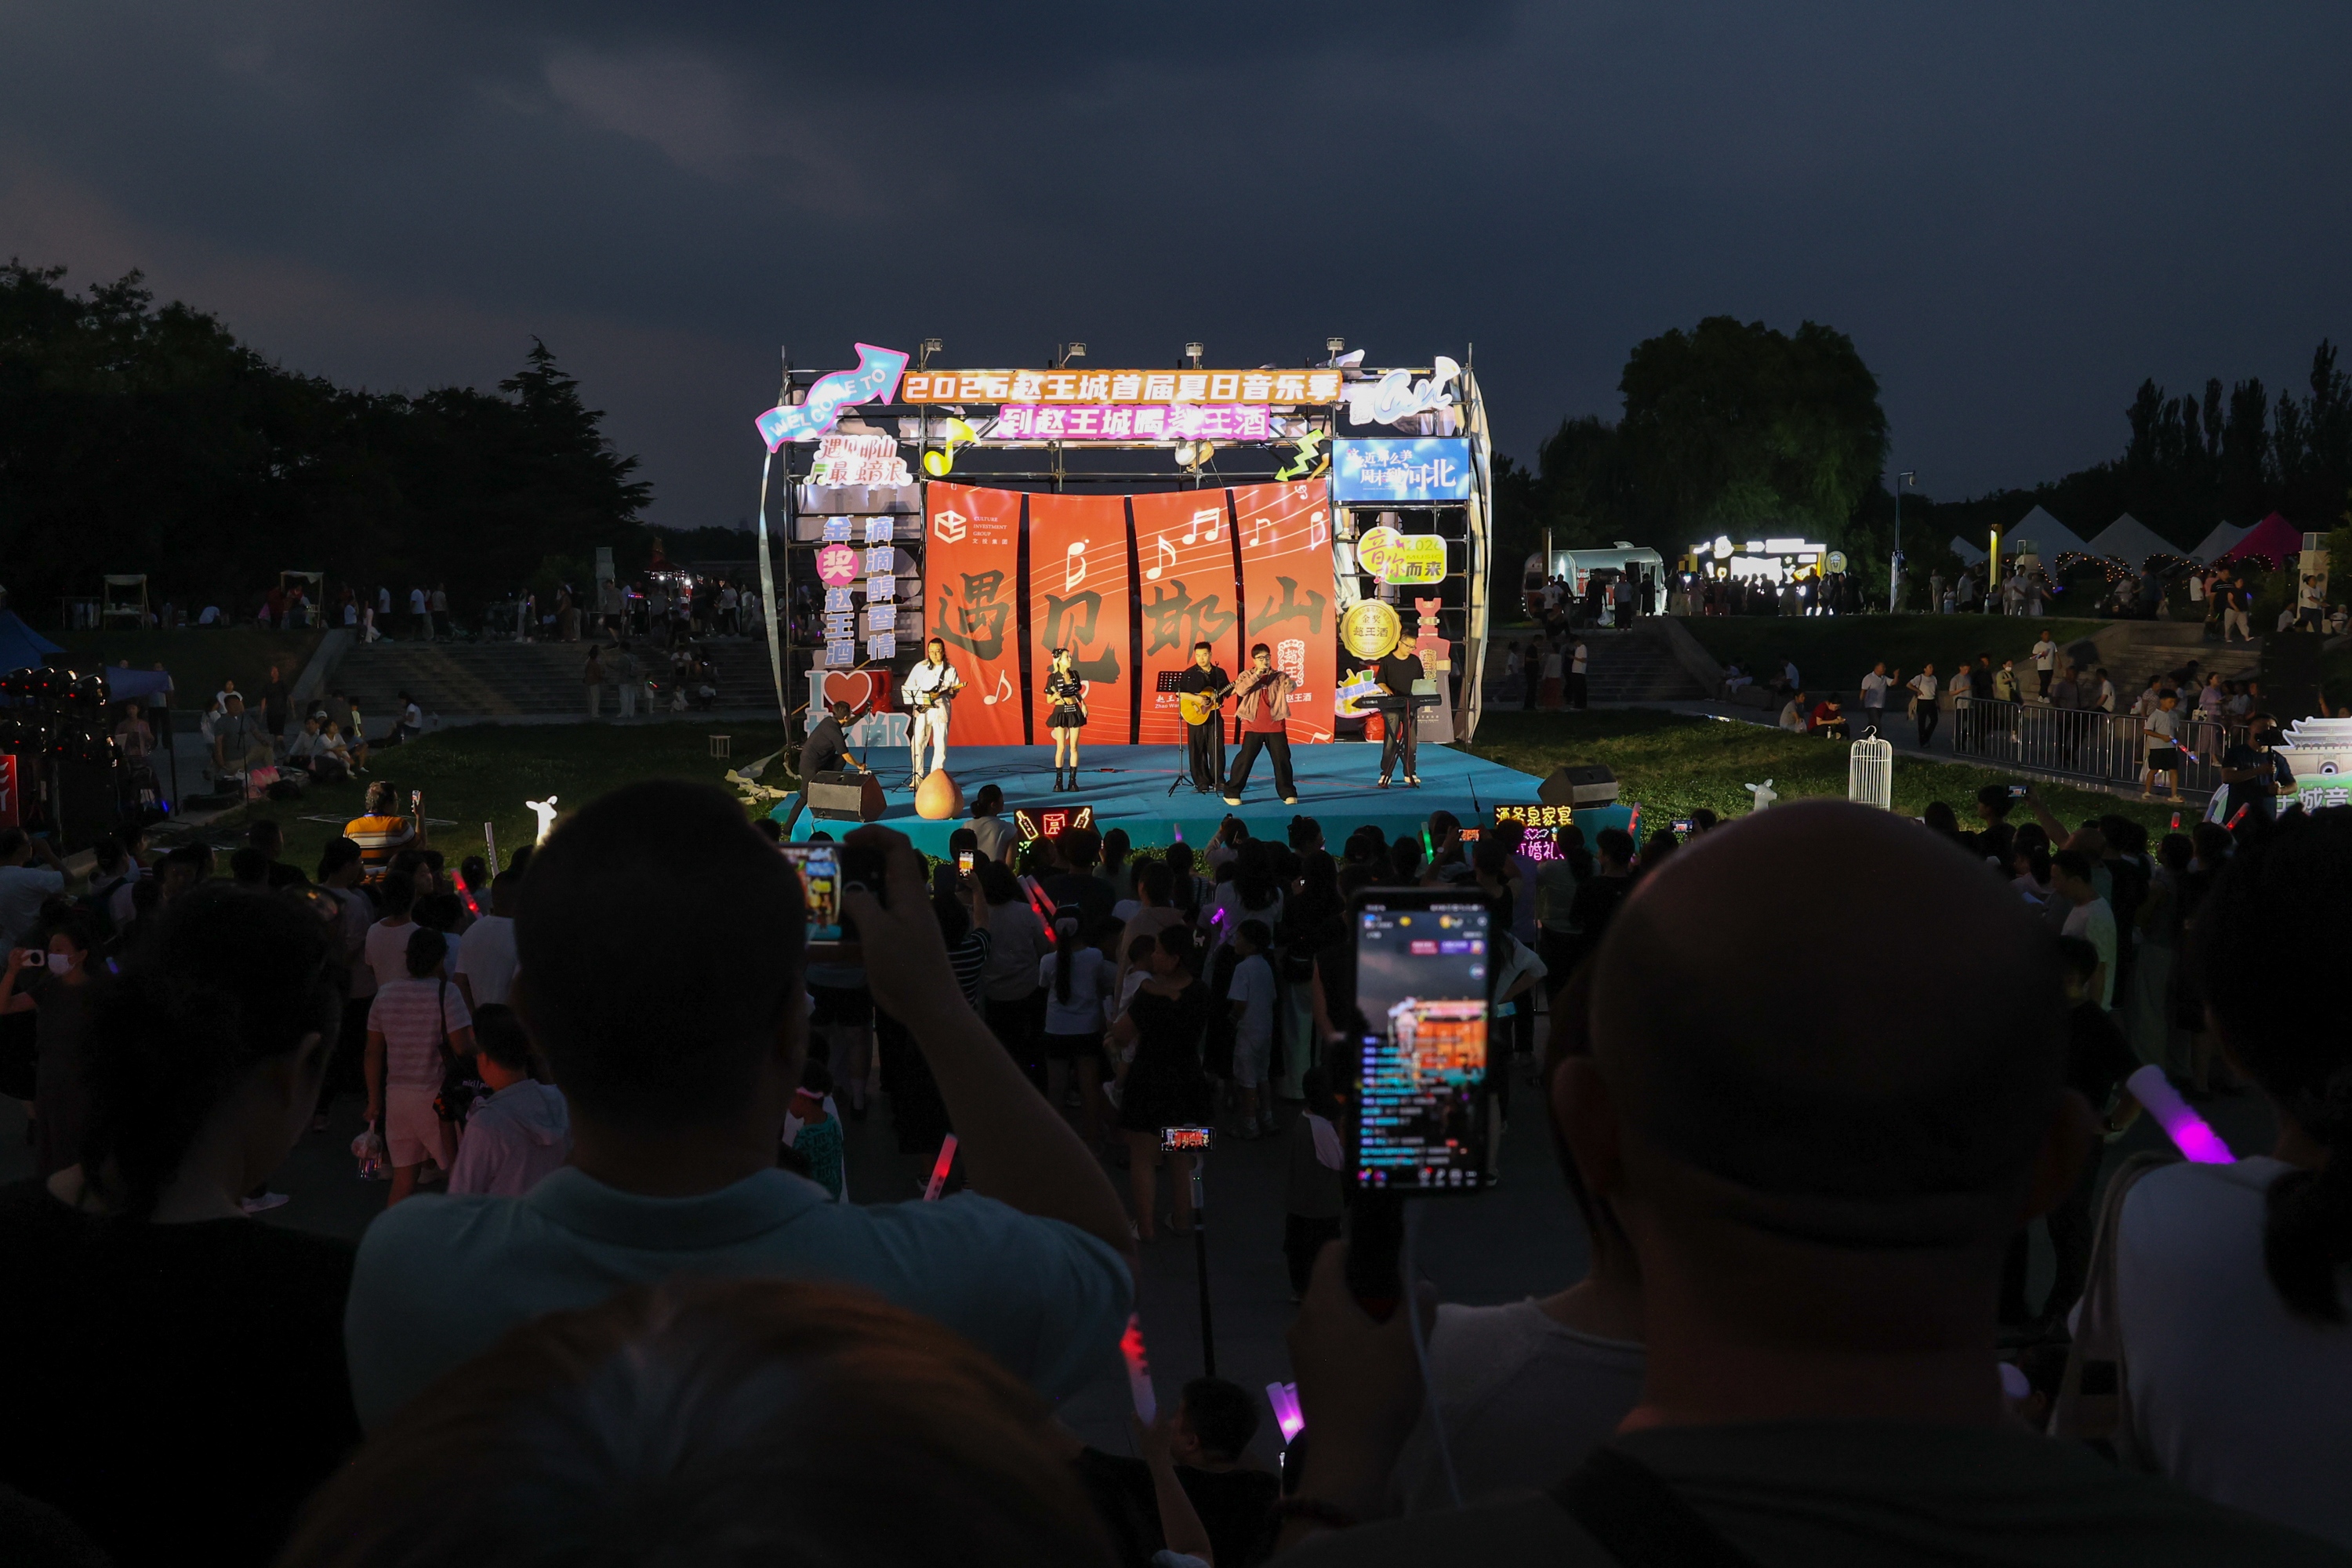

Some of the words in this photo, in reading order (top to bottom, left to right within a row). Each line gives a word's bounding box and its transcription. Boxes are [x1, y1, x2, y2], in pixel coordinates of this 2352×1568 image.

[906, 374, 1339, 402] 2026赵王城首届夏日音乐季
[769, 380, 857, 437] WELCOE
[860, 368, 886, 390] TO
[1406, 539, 1442, 551] 2026
[822, 516, 855, 665] 金奖赵王酒
[865, 516, 897, 660] 滴滴醇香情
[1362, 614, 1381, 624] 金奖
[1156, 694, 1179, 703] 赵王
